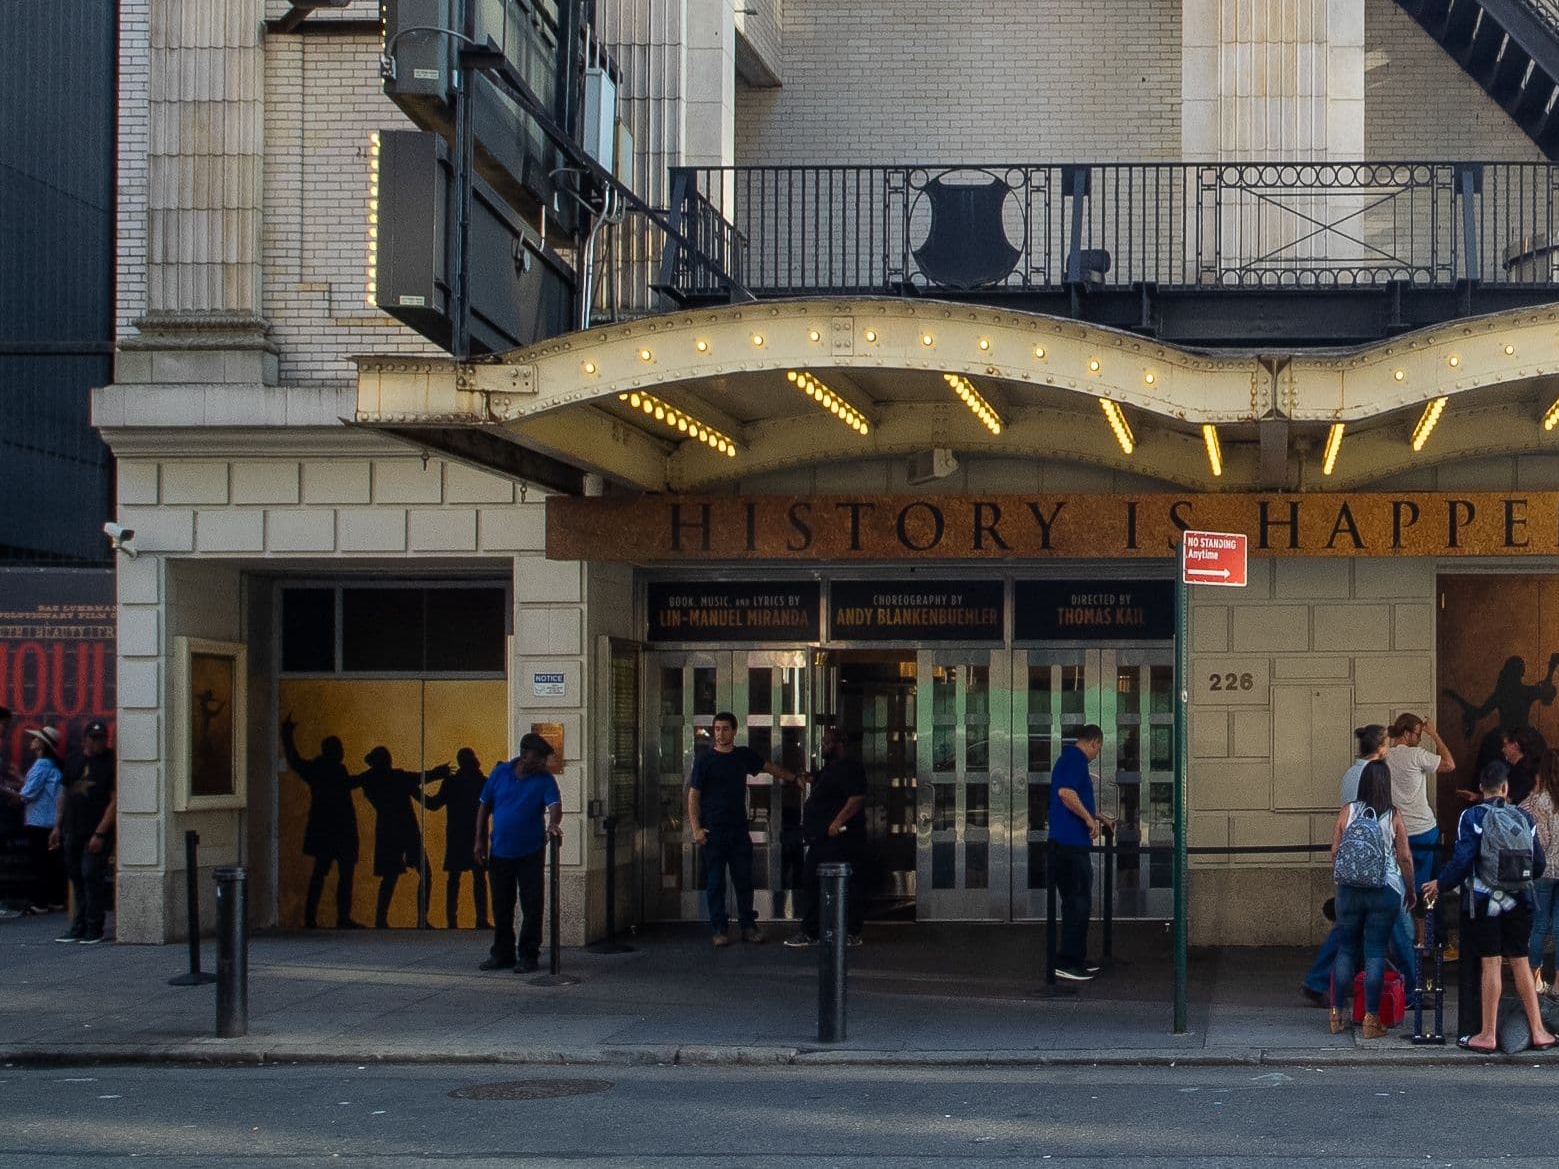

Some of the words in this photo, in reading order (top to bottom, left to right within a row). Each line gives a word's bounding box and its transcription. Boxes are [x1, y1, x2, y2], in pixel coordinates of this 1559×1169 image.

[669, 501, 1067, 551] HISTORY
[1187, 537, 1199, 547] NO
[1200, 537, 1237, 550] STANDING
[1188, 549, 1219, 561] Anytime
[753, 596, 785, 607] LYRICS
[788, 596, 800, 606] BY
[873, 594, 947, 606] CHOREOGRAPHY
[951, 594, 963, 605] BY
[1071, 594, 1115, 605] DIRECTED
[1119, 594, 1132, 605] BY
[660, 608, 743, 627] LIN-MANUEL
[747, 608, 809, 627] MIRANDA
[836, 608, 872, 625] ANDY
[878, 608, 998, 625] BLANKENBUEHLER
[1057, 607, 1112, 625] THOMAS
[535, 674, 563, 683] NOTICE
[1209, 672, 1254, 692] 226
